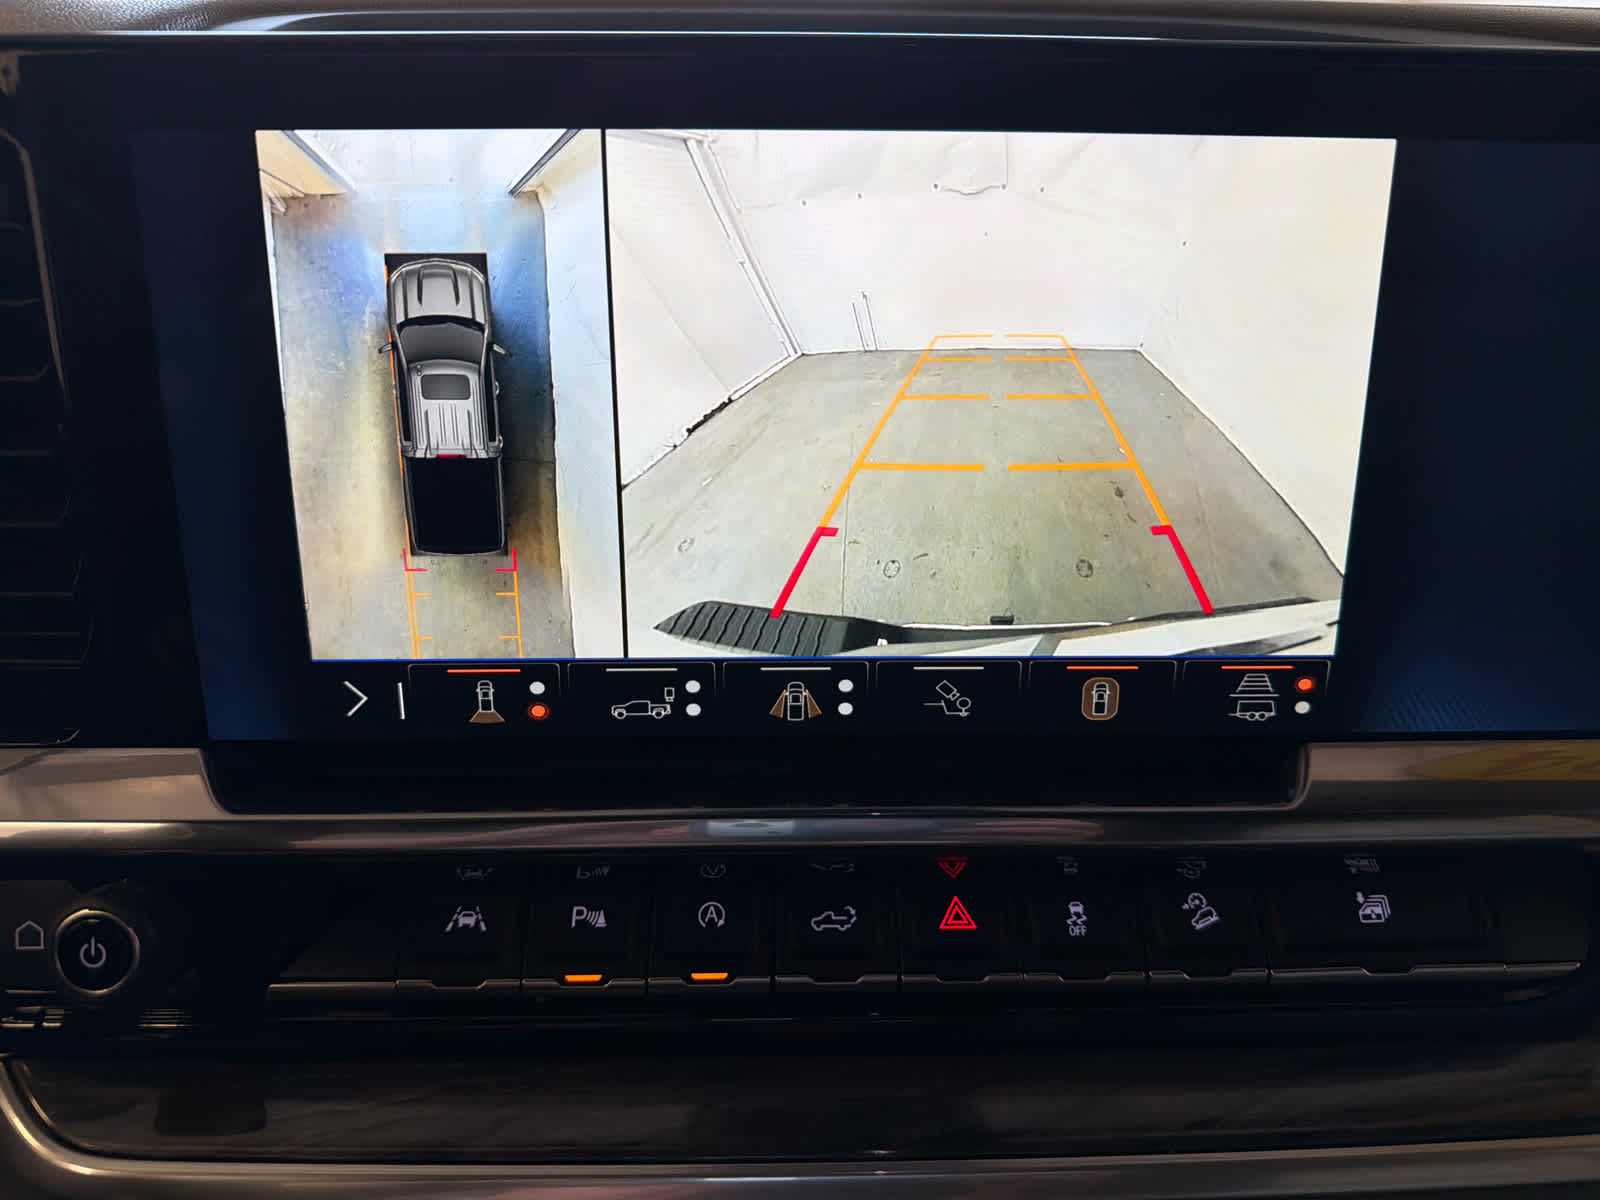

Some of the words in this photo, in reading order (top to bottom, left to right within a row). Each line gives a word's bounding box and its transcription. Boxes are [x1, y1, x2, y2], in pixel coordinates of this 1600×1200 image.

[571, 906, 587, 928] P
[705, 906, 718, 922] A
[1069, 925, 1087, 937] OFF
